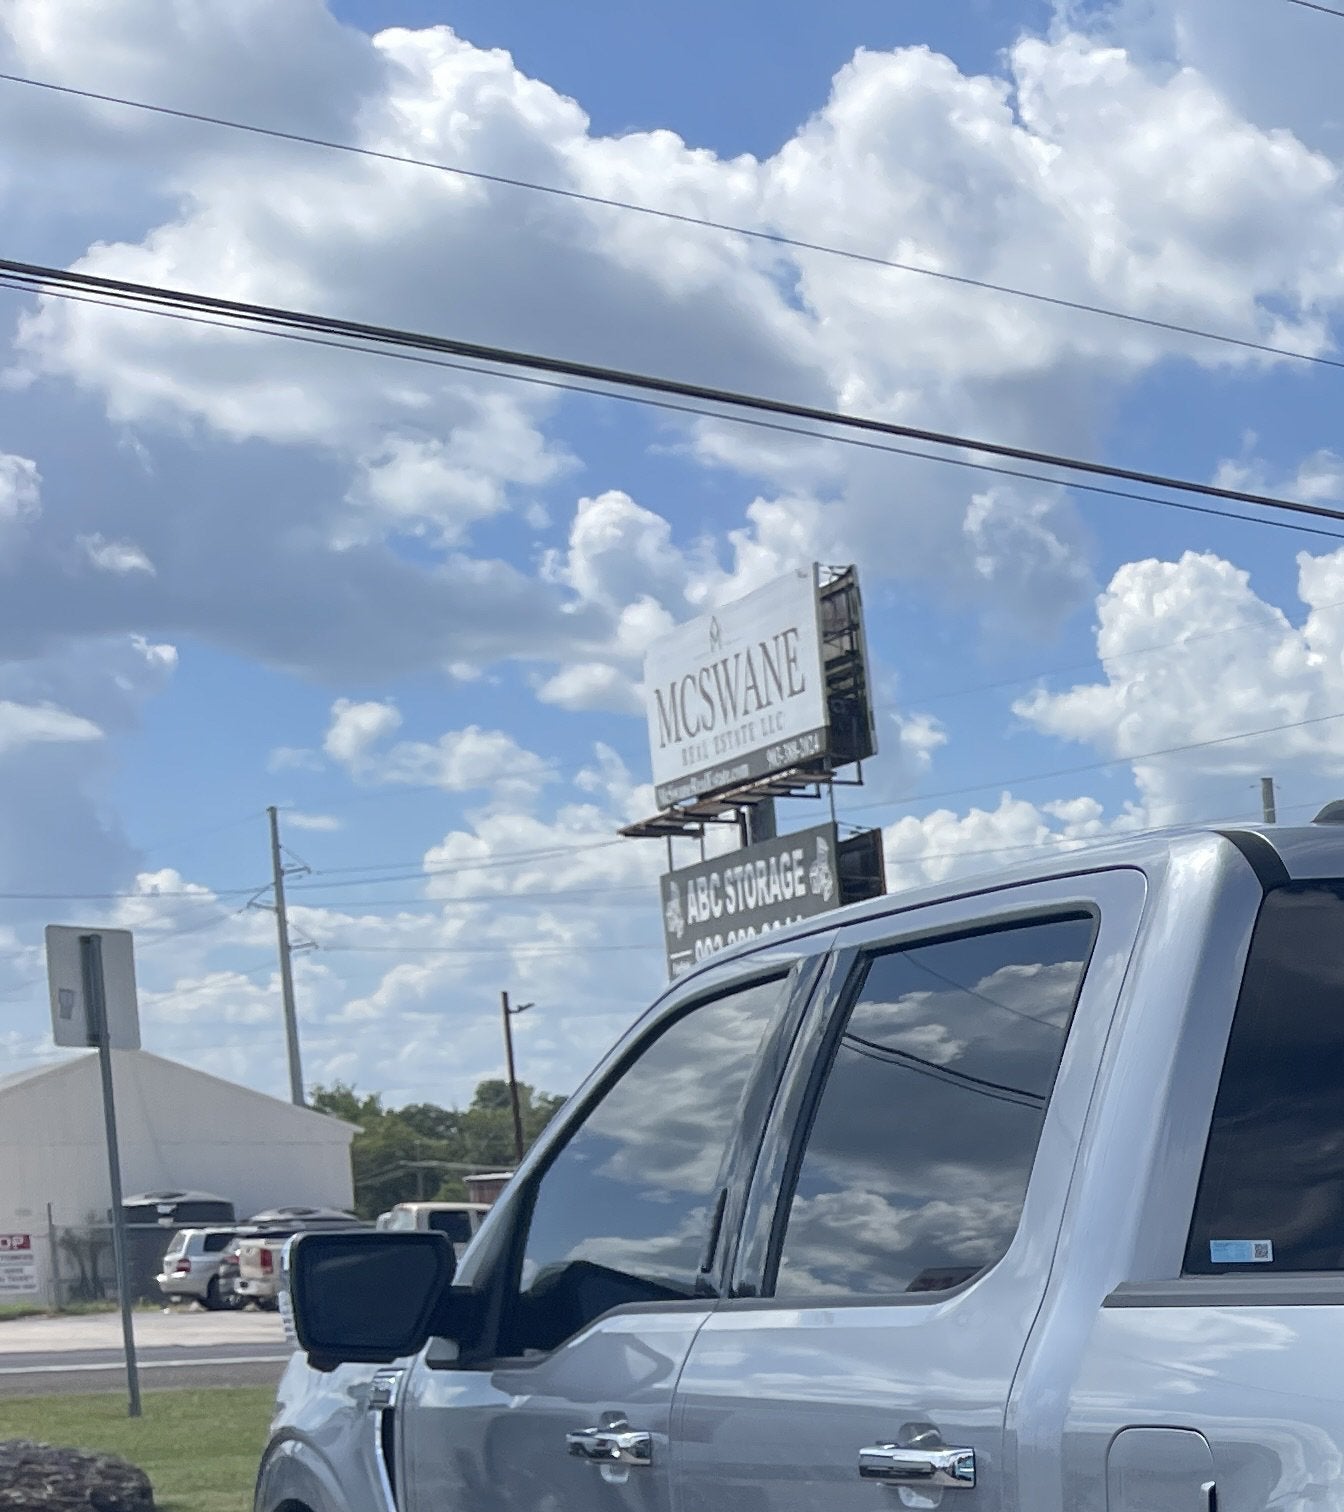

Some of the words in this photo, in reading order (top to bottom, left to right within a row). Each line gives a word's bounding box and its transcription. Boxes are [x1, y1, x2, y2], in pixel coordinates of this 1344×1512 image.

[654, 627, 806, 748] MCSWANE
[762, 711, 785, 737] LLC
[687, 872, 722, 925] ABC
[724, 849, 806, 915] STORAGE
